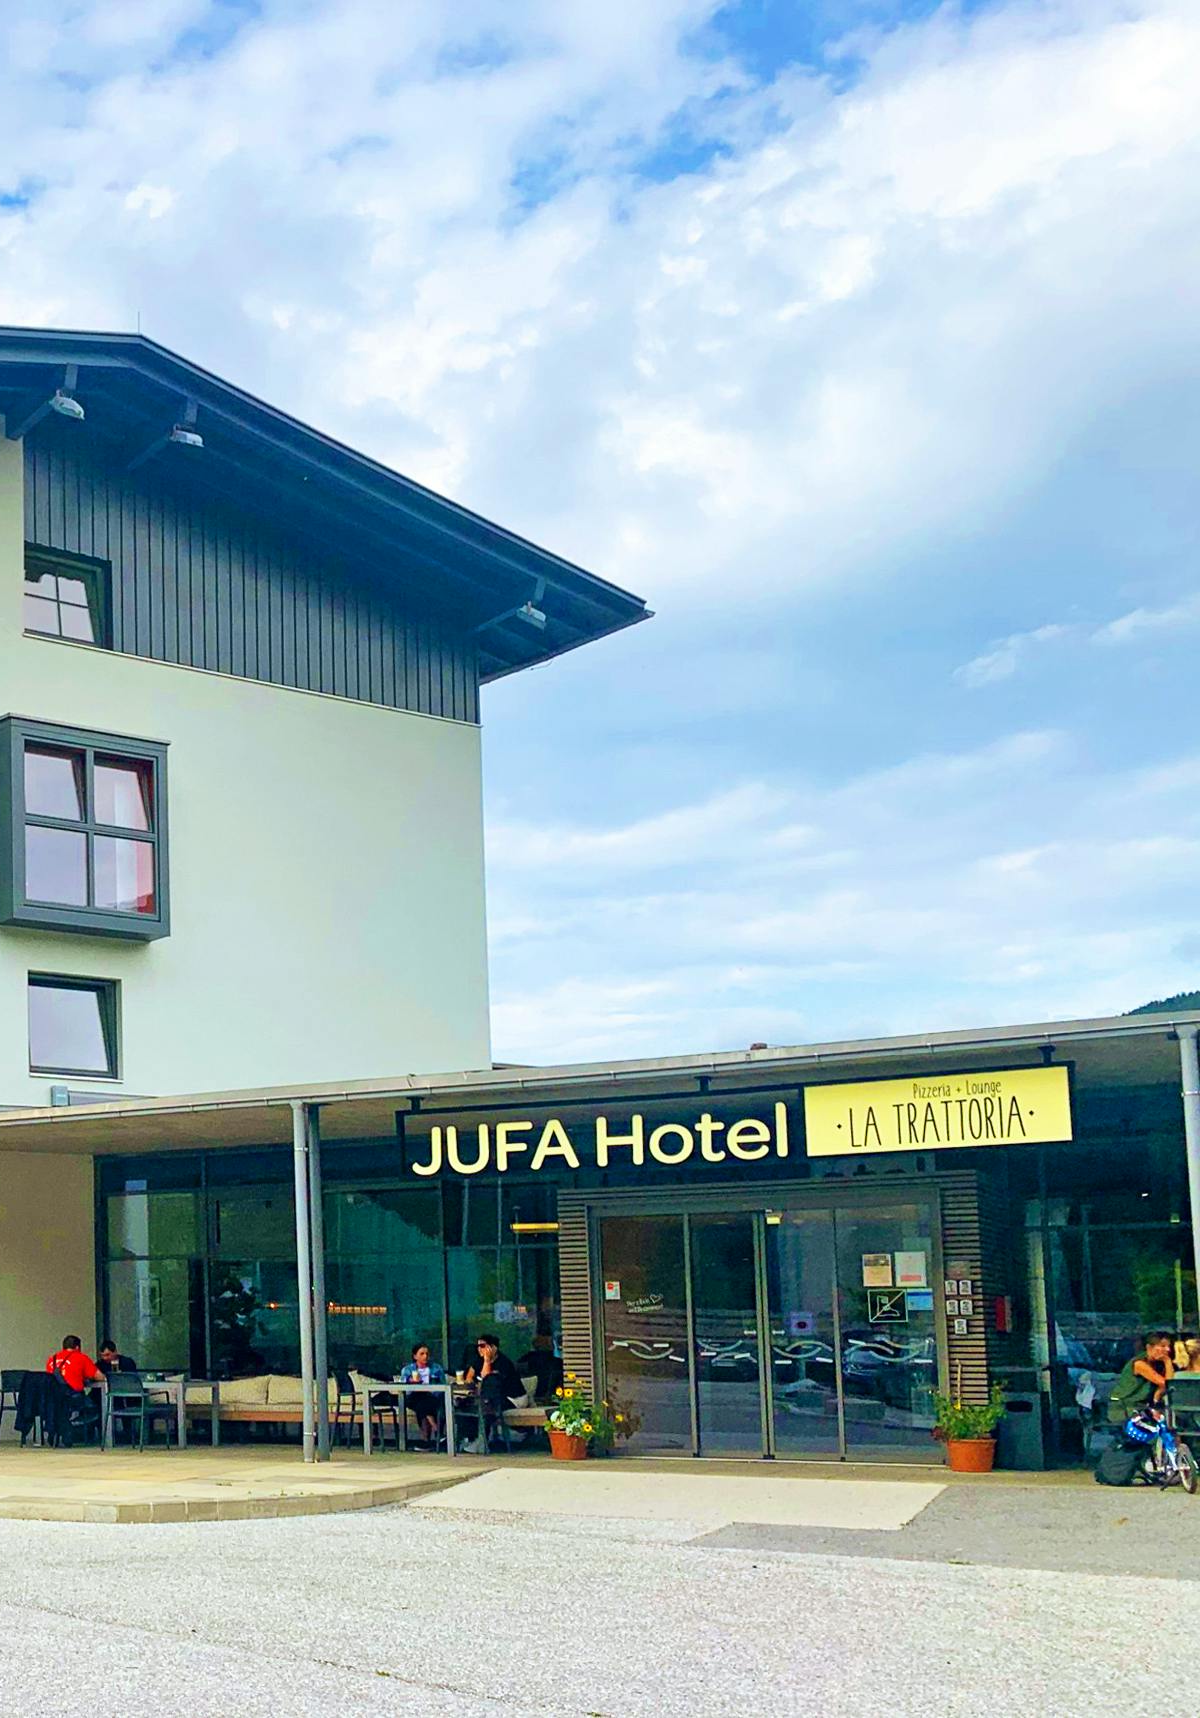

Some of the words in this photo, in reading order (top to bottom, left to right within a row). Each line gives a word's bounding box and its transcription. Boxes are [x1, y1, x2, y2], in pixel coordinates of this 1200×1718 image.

[912, 1083, 951, 1099] Pizzeria
[966, 1079, 1002, 1099] Lounge
[412, 1119, 580, 1176] JUFA
[596, 1101, 789, 1168] Hotel
[849, 1106, 882, 1147] LA
[892, 1095, 1026, 1144] TRATTORIA
